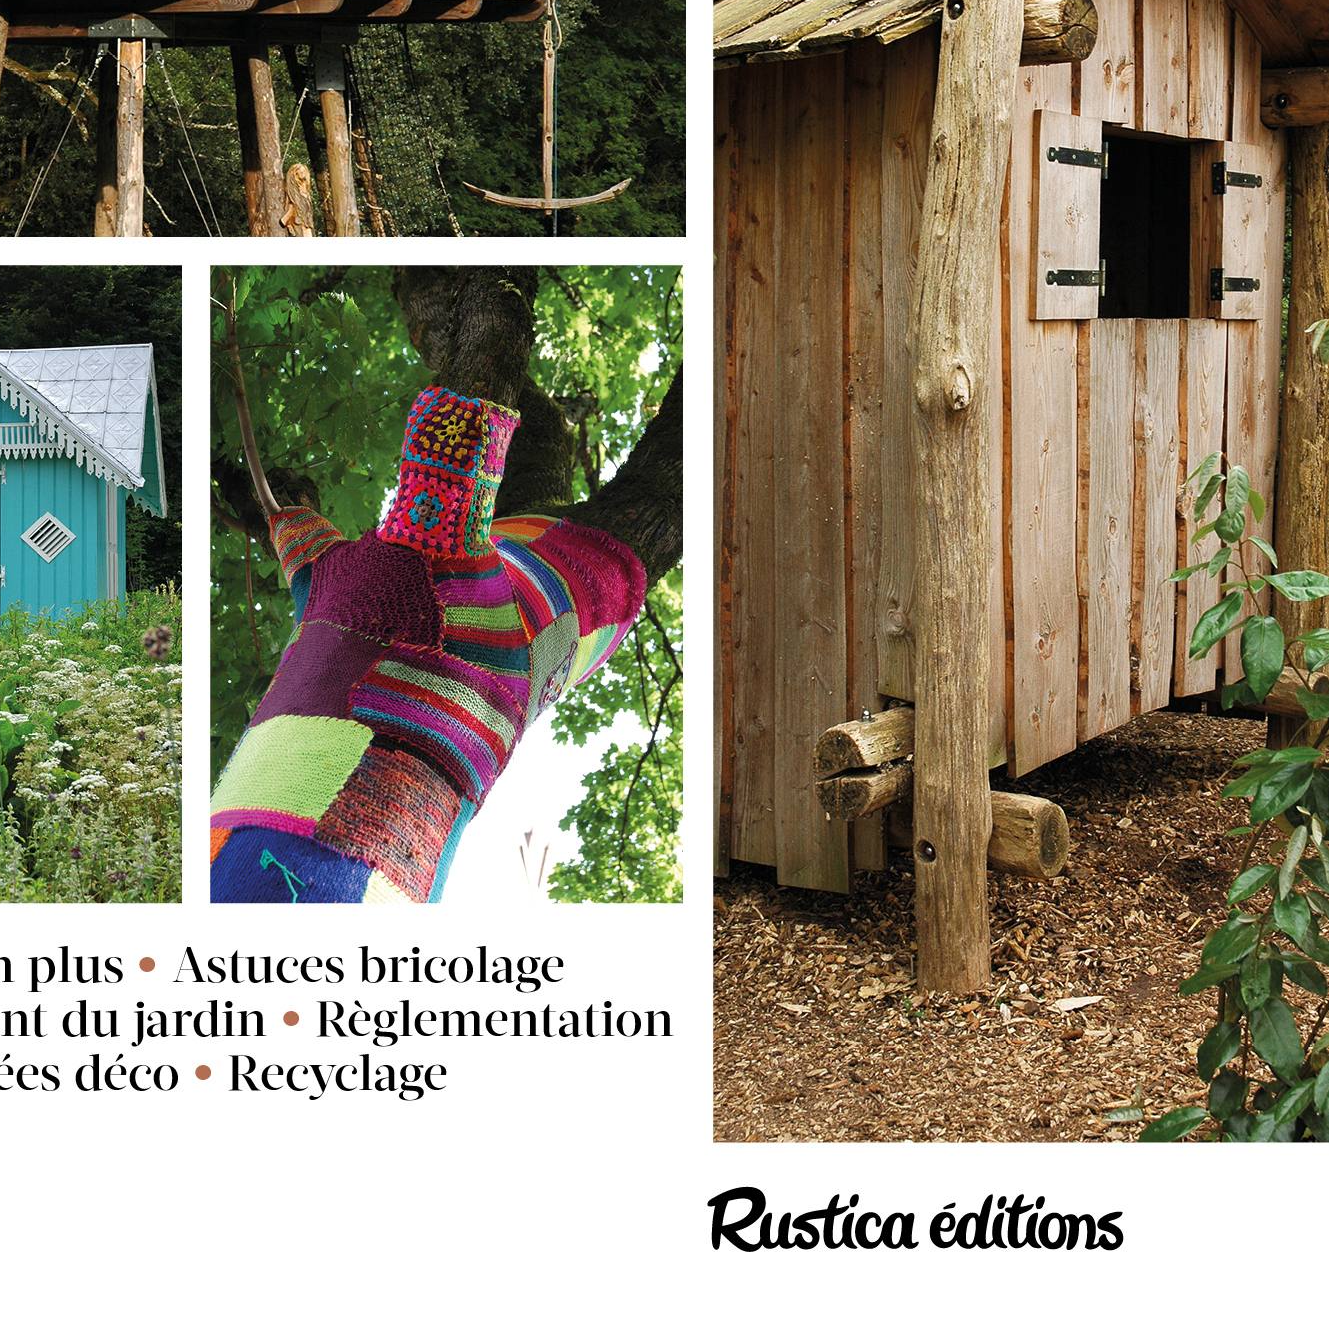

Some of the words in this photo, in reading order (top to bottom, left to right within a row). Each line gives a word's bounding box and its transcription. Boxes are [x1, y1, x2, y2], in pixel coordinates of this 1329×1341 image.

[28, 946, 123, 992] plus
[173, 947, 344, 983] Astuces
[358, 946, 563, 993] bricolage
[63, 1000, 120, 1037] du
[132, 1000, 266, 1047] jardin
[317, 1000, 673, 1047] Règlementation
[76, 1054, 178, 1091] déco
[229, 1054, 446, 1101] Recyclage
[707, 1187, 919, 1252] Rustica
[930, 1194, 1123, 1250] éditions
